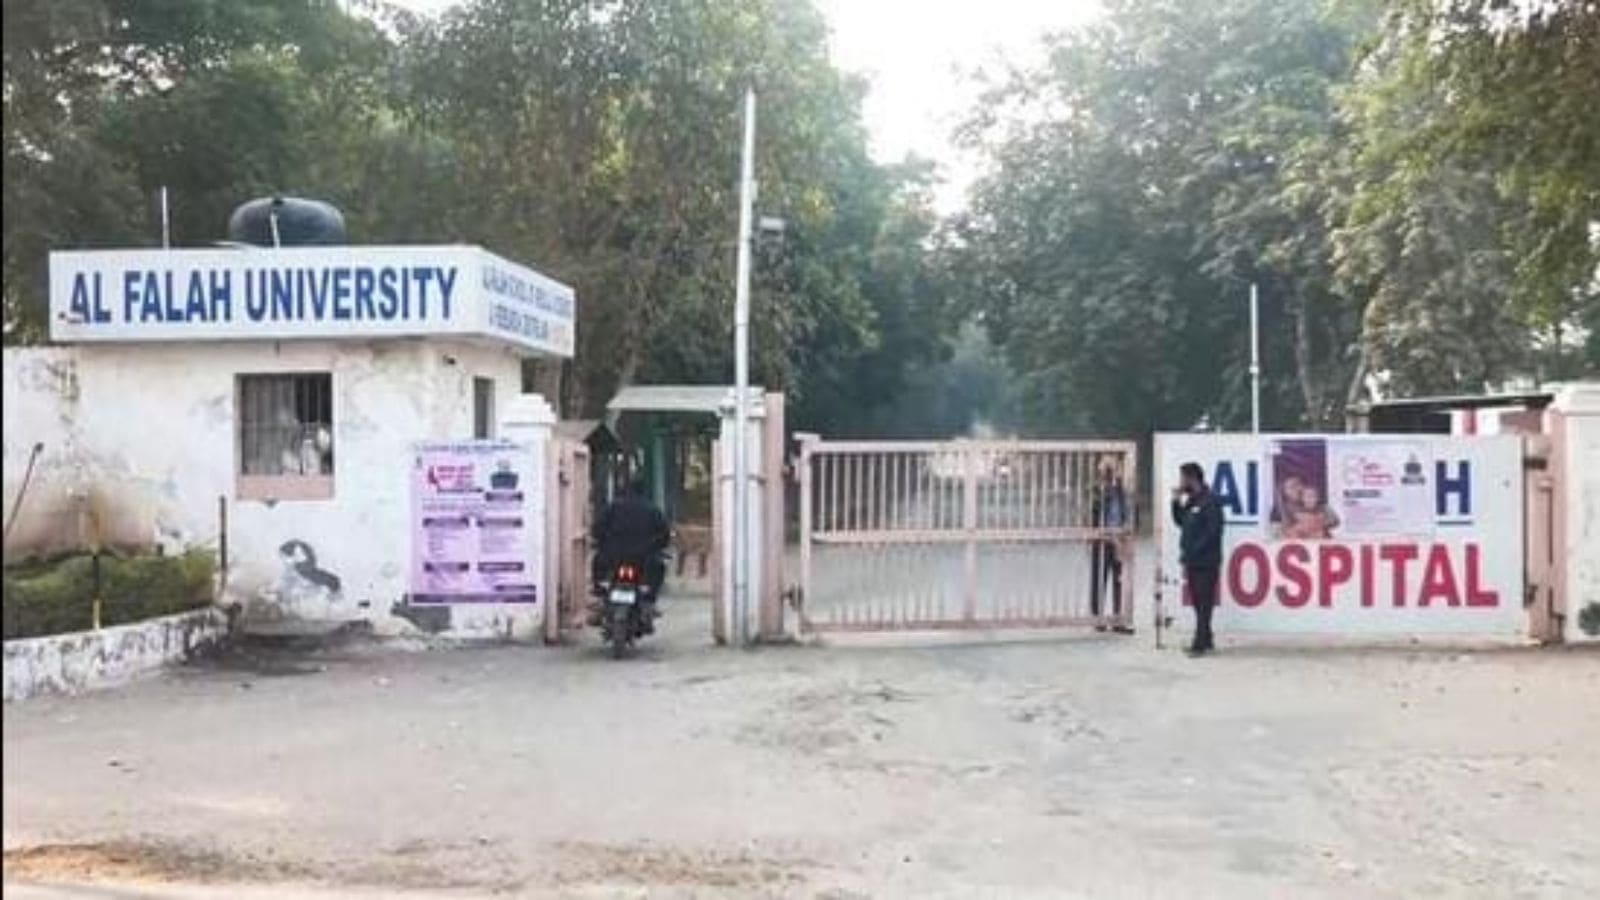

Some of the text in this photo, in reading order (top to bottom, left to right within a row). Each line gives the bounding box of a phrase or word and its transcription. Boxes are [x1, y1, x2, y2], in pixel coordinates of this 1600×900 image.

[69, 271, 111, 324] AL
[124, 269, 231, 324] FALAH
[245, 266, 457, 322] UNIVERSITY
[1183, 542, 1499, 608] OSPITAL
